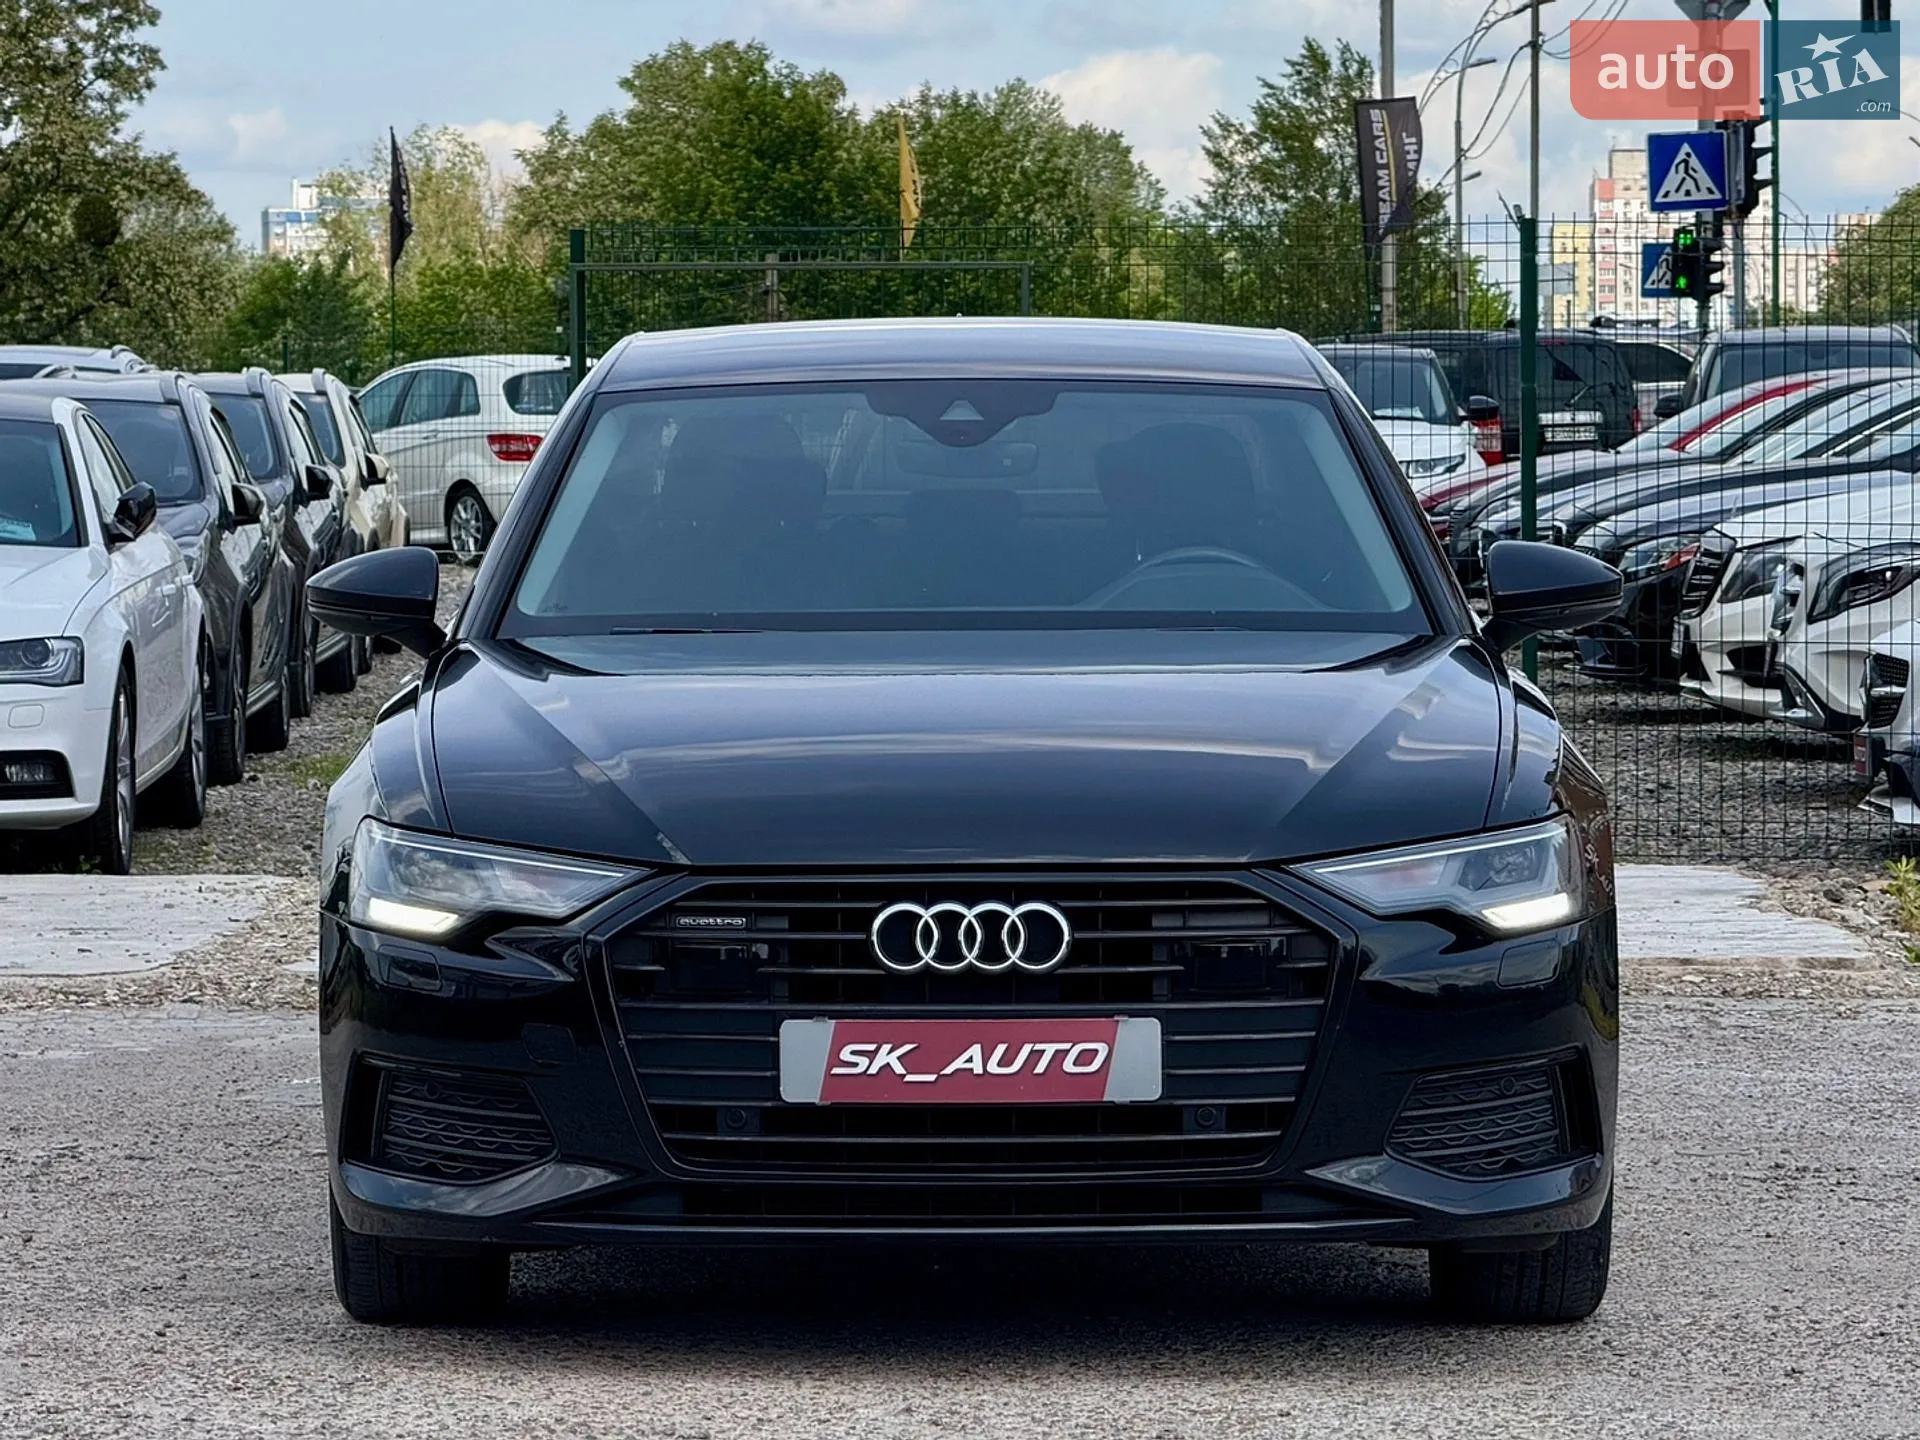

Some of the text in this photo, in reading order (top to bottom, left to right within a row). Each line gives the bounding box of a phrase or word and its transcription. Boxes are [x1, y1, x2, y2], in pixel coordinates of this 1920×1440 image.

[1369, 108, 1392, 235] REAM CARS
[679, 917, 743, 926] quattro
[830, 1041, 1110, 1083] SK_AUTO
